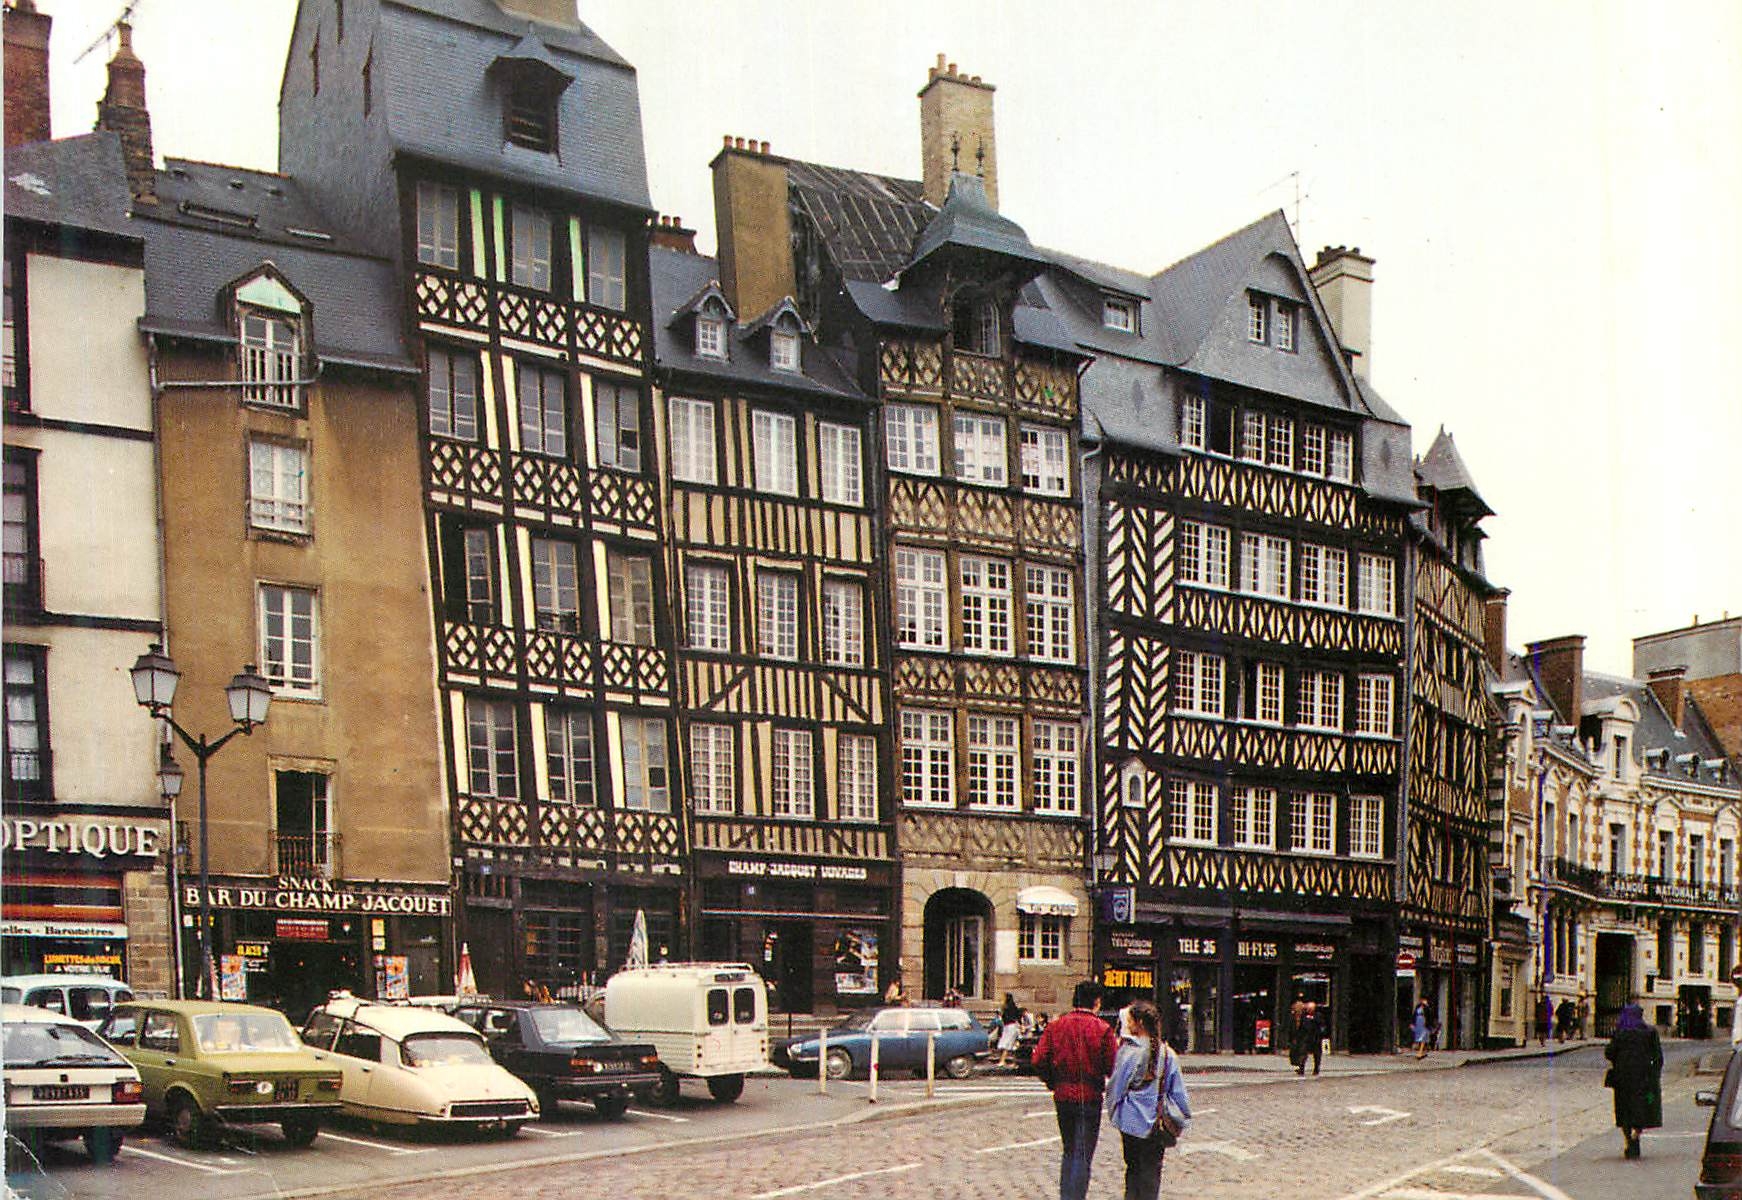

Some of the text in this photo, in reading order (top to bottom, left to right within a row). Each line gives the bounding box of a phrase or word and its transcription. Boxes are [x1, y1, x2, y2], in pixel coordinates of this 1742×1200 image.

[278, 877, 332, 892] SNACK
[1614, 880, 1649, 896] BANQUE
[1655, 884, 1700, 900] NATIONALE
[1708, 888, 1720, 902] DE
[240, 889, 267, 907] DU
[275, 891, 355, 910] CHAMP
[361, 894, 451, 914] JACQUET
